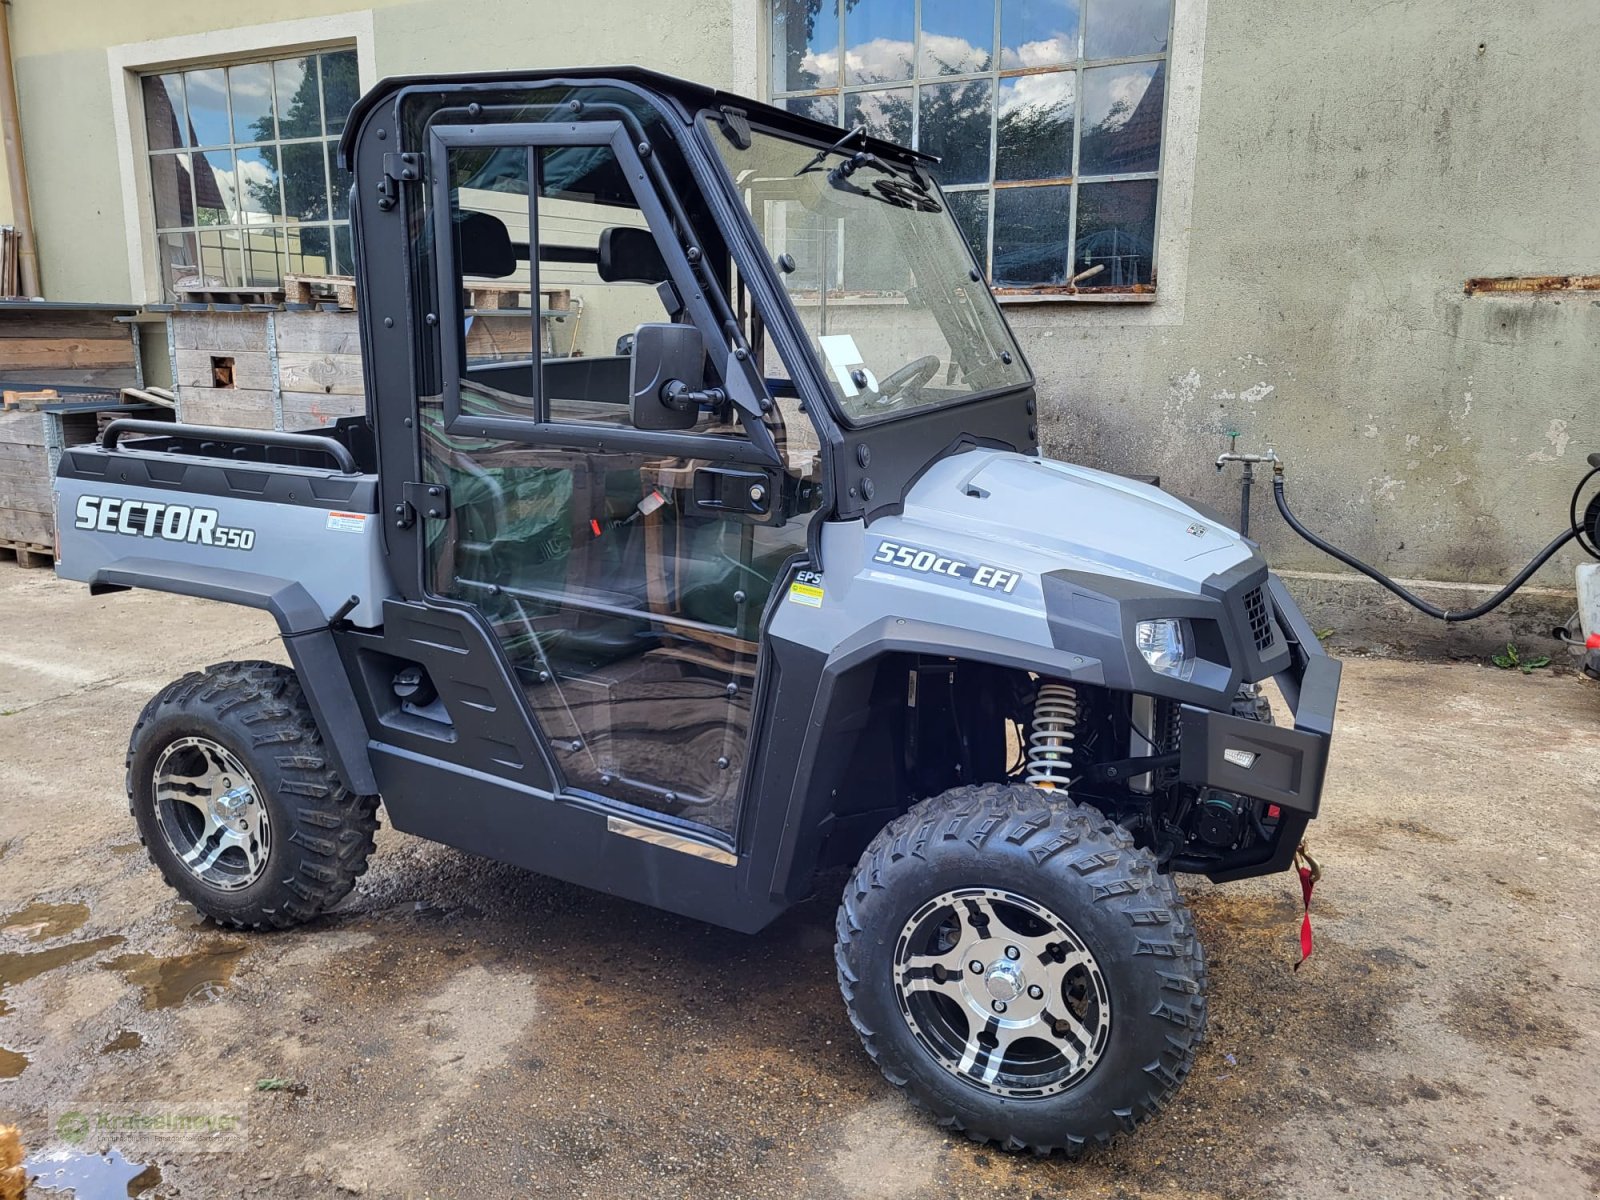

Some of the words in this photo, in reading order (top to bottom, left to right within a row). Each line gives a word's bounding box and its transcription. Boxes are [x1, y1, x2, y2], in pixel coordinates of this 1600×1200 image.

[75, 495, 218, 545] SECTOR
[214, 527, 255, 549] 550
[796, 570, 822, 584] EPS
[873, 541, 967, 577] 550cc
[971, 566, 1020, 593] EFI
